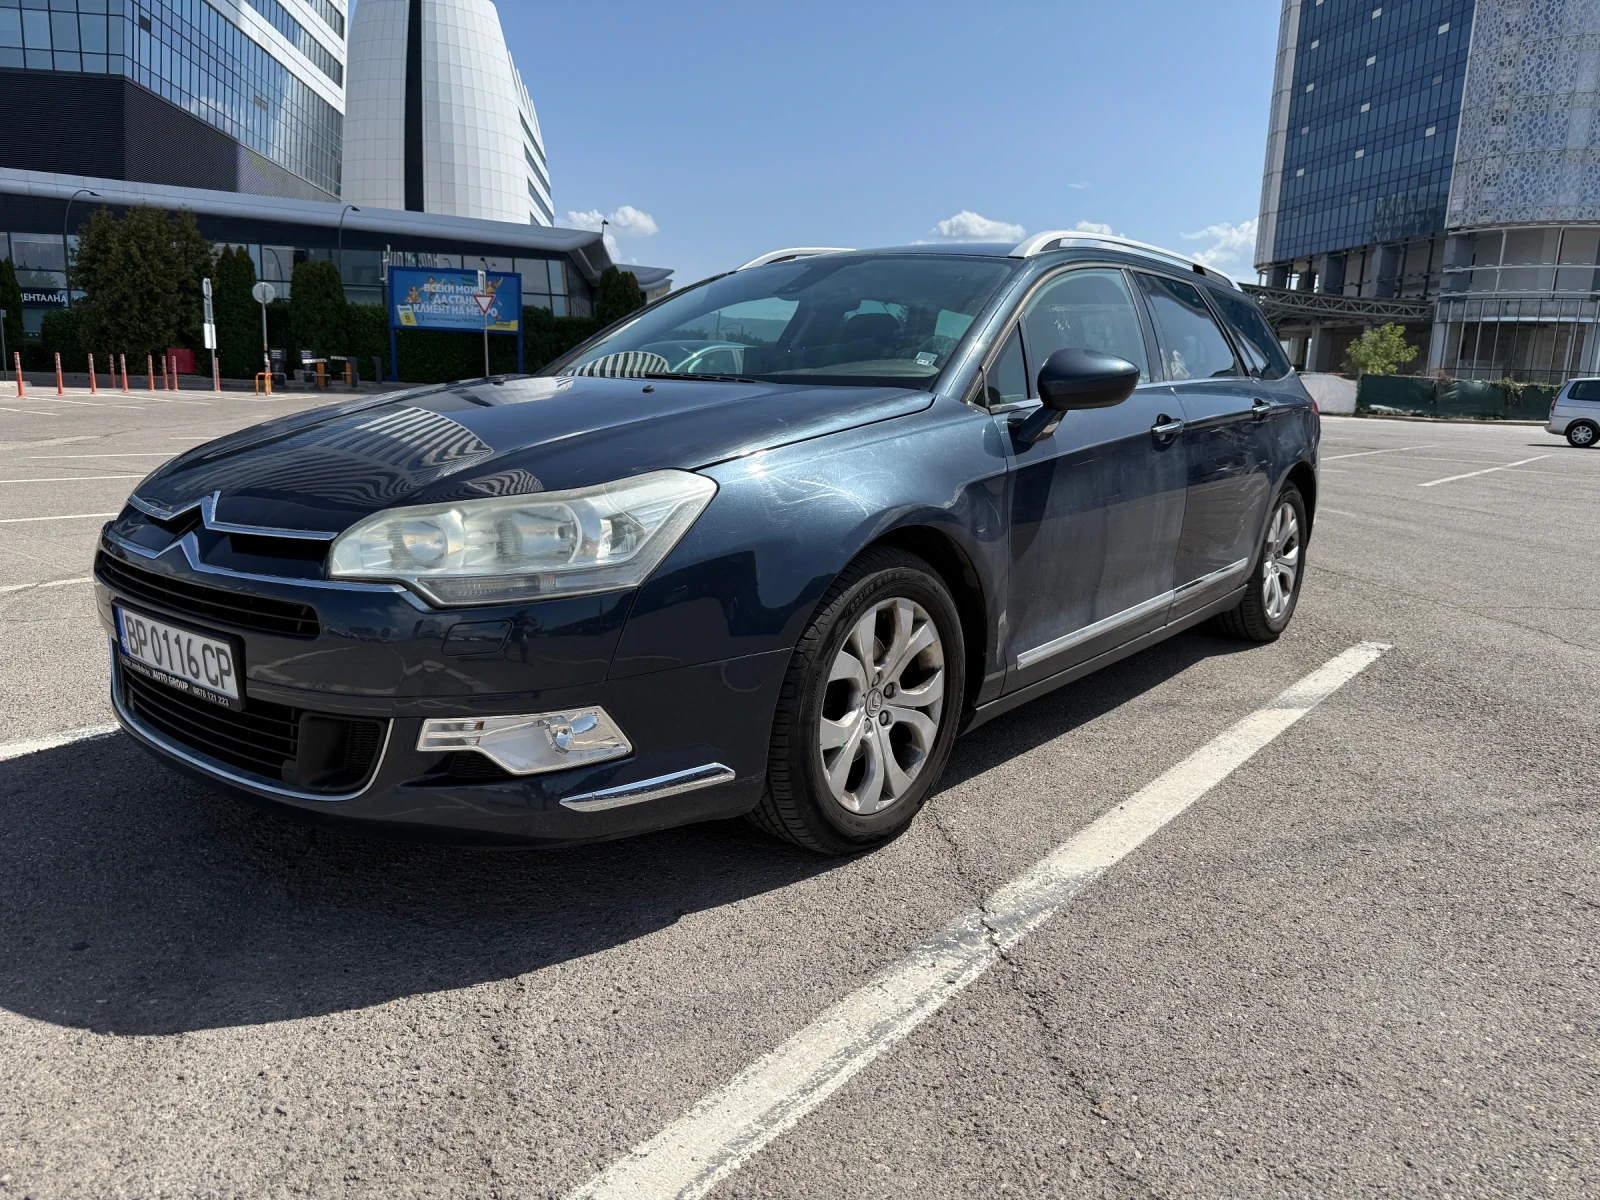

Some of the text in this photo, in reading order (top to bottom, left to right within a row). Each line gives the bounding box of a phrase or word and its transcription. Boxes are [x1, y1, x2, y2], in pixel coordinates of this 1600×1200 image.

[423, 284, 482, 295] ВСЕКИ МОЖ
[433, 294, 448, 304] ДА
[413, 303, 450, 314] КЛИЕНТ
[452, 306, 466, 315] НА
[152, 670, 168, 683] AUTO
[169, 675, 189, 690] GROUP
